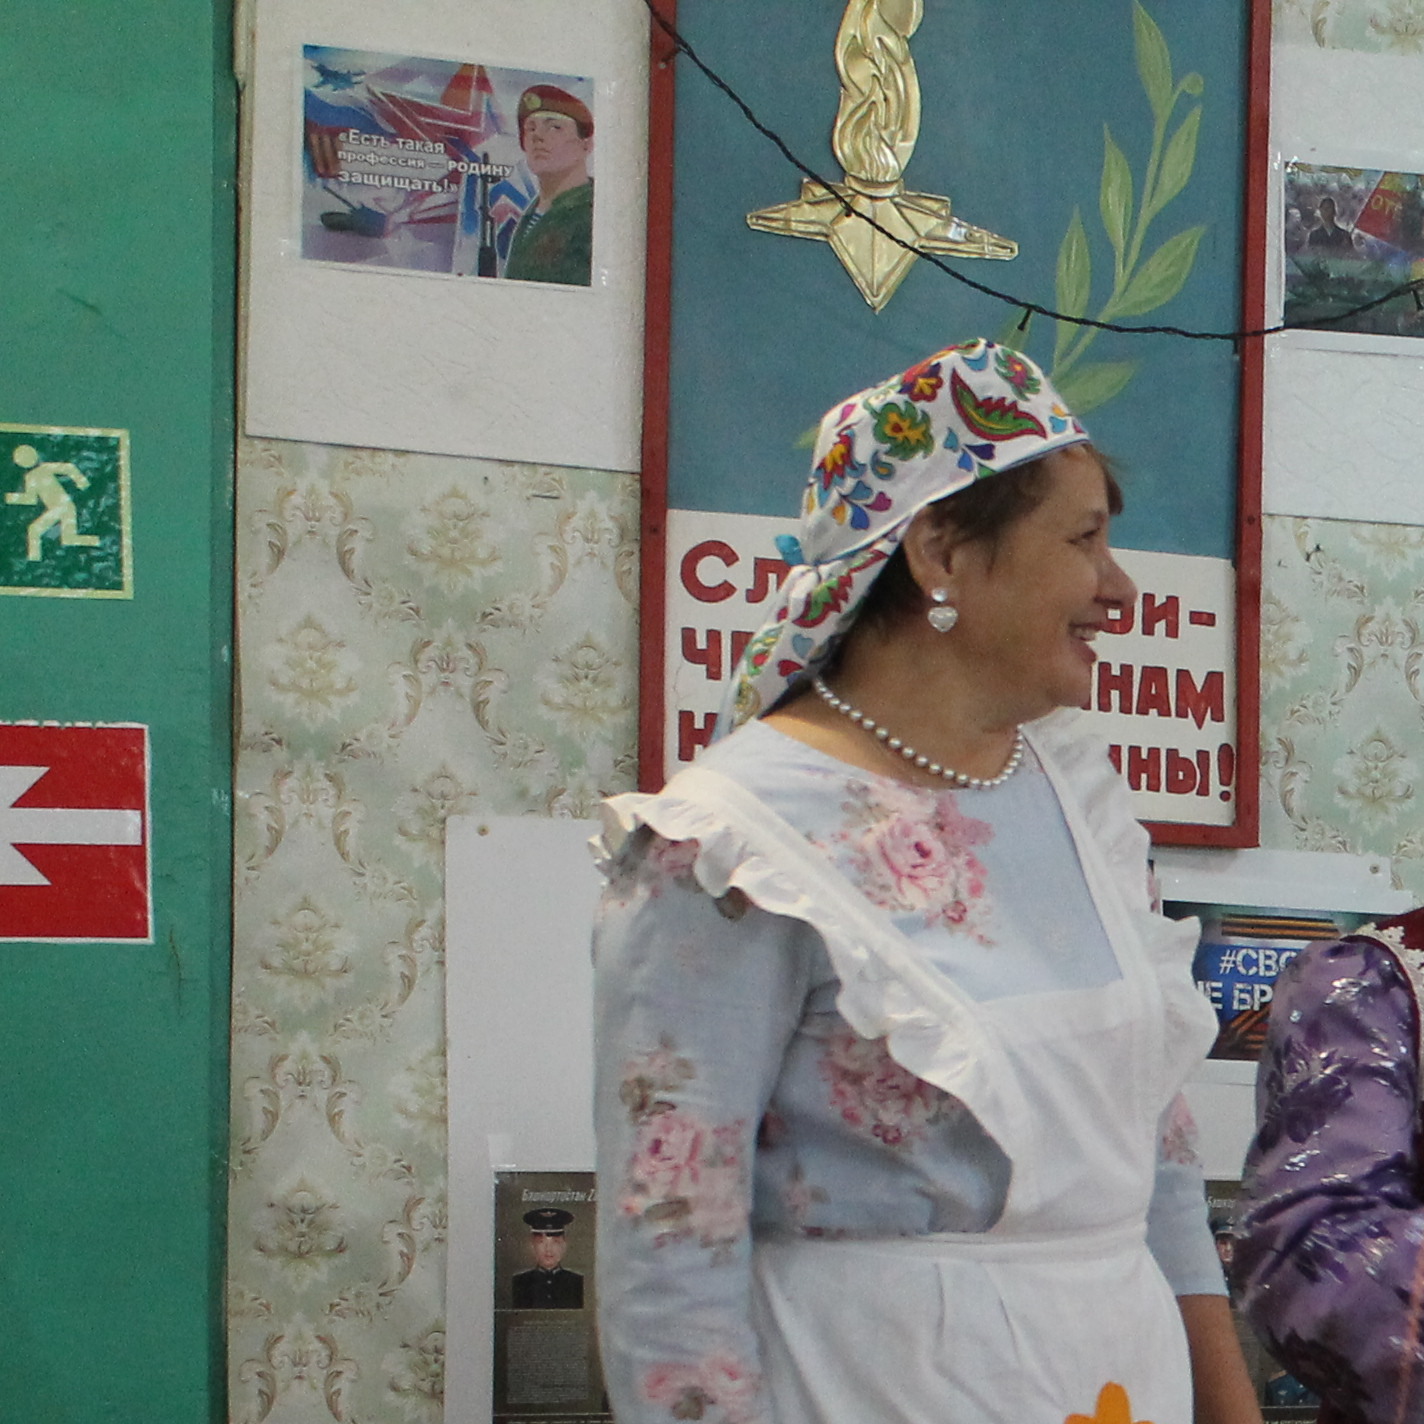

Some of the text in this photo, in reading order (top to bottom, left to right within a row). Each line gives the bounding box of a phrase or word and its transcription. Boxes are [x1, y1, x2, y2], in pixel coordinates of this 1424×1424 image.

[396, 138, 445, 153] такая
[338, 151, 425, 168] профессия
[1082, 661, 1225, 730] НАМ
